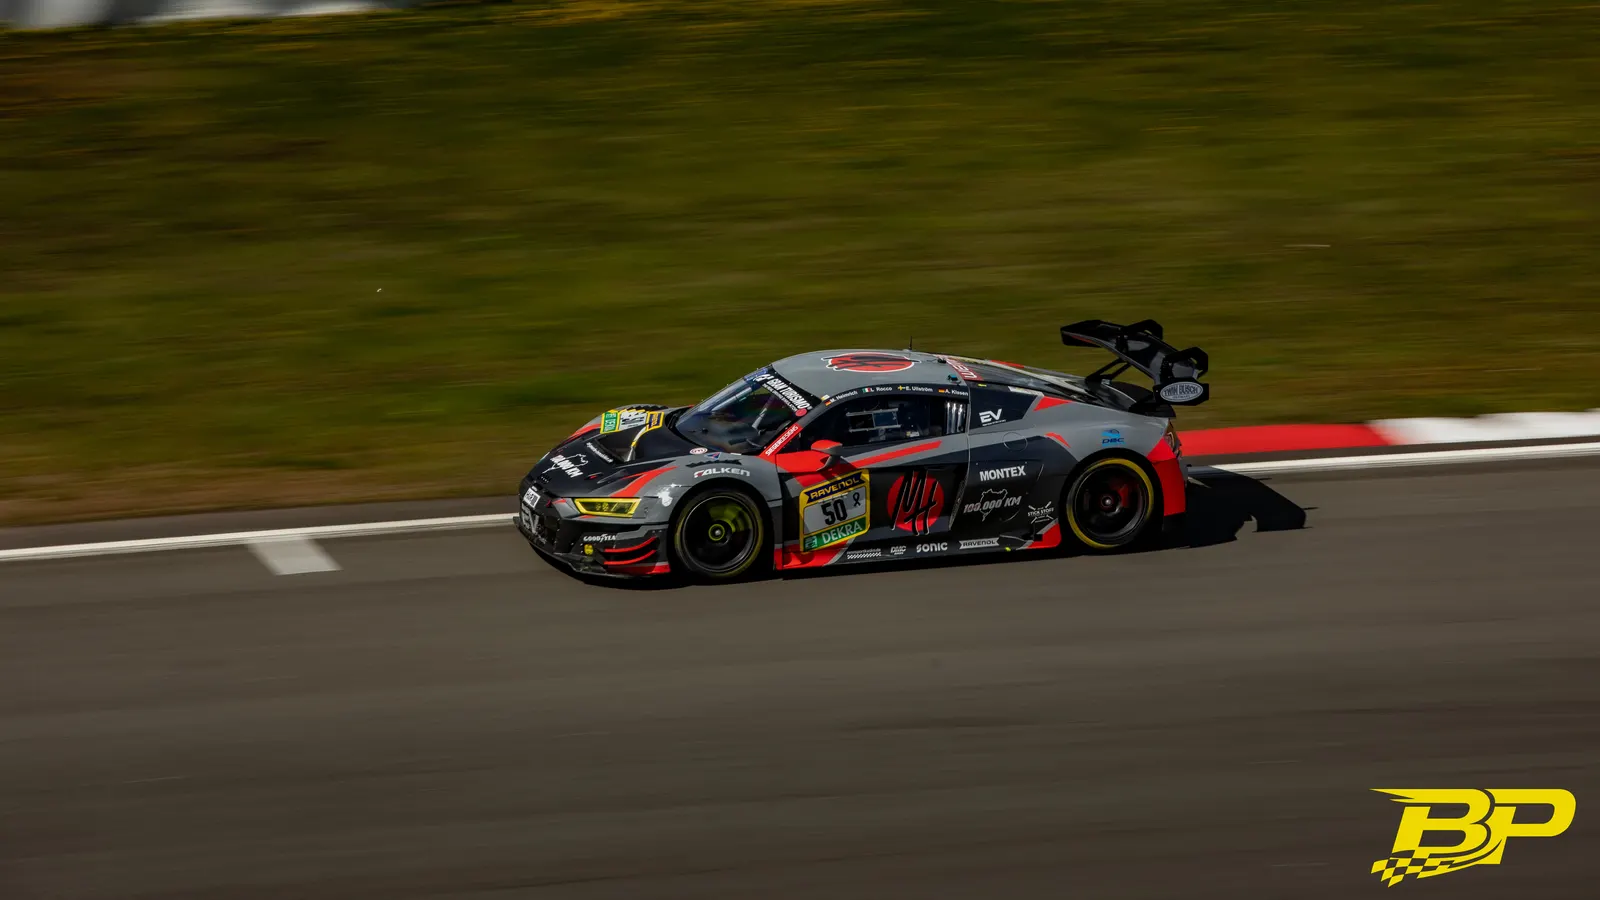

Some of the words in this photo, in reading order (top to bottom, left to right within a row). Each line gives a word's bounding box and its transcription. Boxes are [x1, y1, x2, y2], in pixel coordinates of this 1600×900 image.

[979, 408, 1002, 423] EV
[979, 465, 1026, 481] MONTEX
[810, 475, 860, 500] RAVENOL
[821, 498, 848, 526] 50
[963, 499, 1001, 514] 100.000
[1004, 496, 1022, 508] KM
[822, 521, 863, 545] DEKRA
[916, 541, 948, 553] SONIC
[963, 539, 996, 547] RAVENOL
